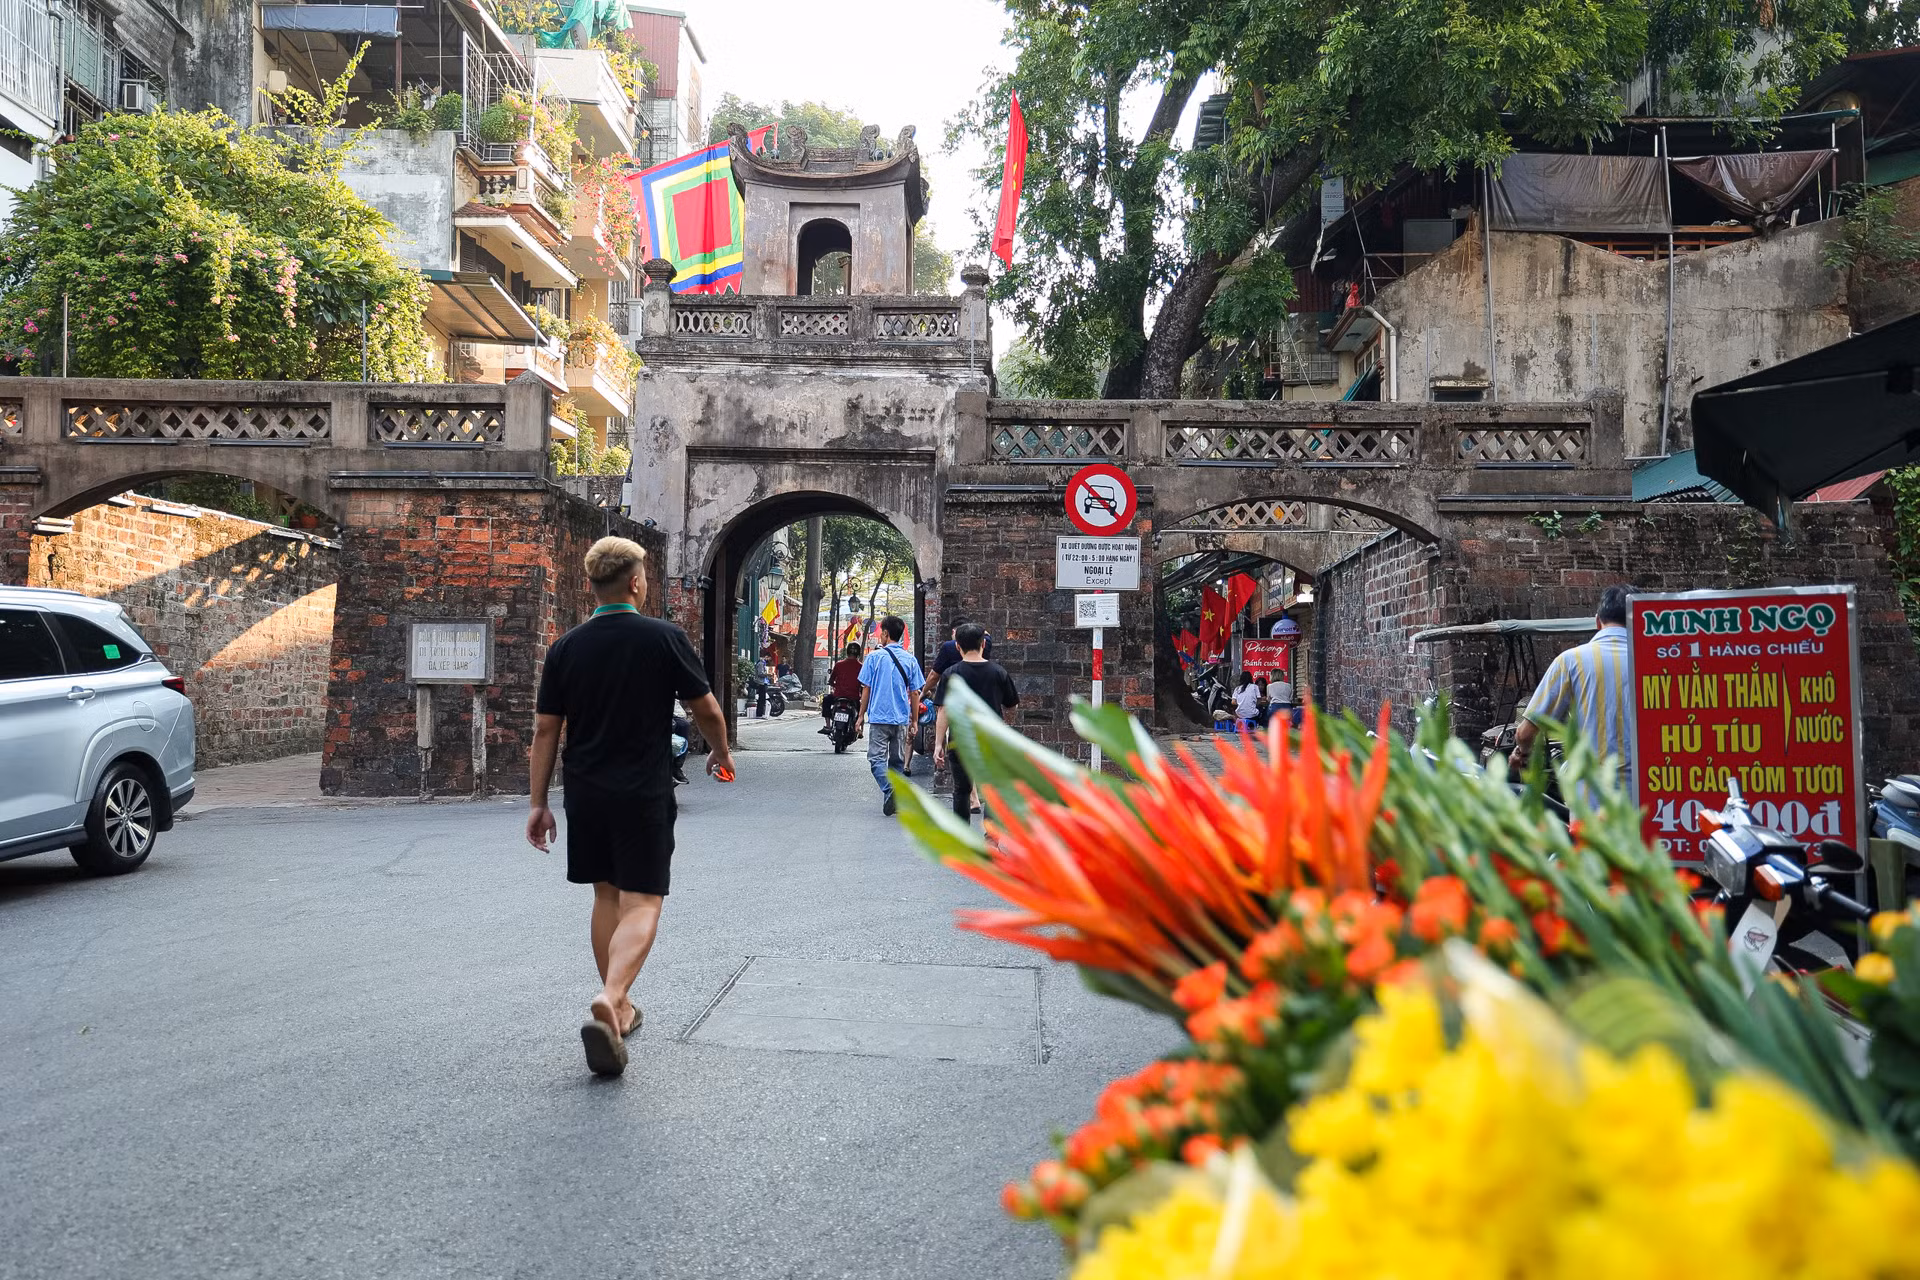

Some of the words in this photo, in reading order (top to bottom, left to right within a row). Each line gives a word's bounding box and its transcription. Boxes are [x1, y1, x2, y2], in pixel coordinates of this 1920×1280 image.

[1084, 565, 1104, 576] NGOẠI
[1105, 565, 1113, 576] LỆ
[1086, 576, 1112, 586] Except
[1642, 606, 1742, 636] MINH
[1748, 603, 1836, 637] NGỌ
[1243, 658, 1262, 667] Bánh
[1656, 642, 1682, 658] SỐ
[1688, 641, 1703, 658] 1
[1709, 642, 1761, 657] HÀNG
[1767, 638, 1825, 655] CHIẾU
[1643, 668, 1672, 709] MỲ
[1677, 661, 1718, 709] VẰN
[1724, 662, 1778, 708] THẮN
[1800, 671, 1836, 704] KHÔ
[1661, 714, 1702, 753] HỦ
[1711, 718, 1762, 753] TÍU
[1795, 708, 1844, 743] NƯỚC
[1648, 756, 1682, 792] SỦI
[1689, 756, 1732, 792] CẢO
[1737, 761, 1786, 793] TÔM
[1792, 764, 1844, 794] TƯƠI
